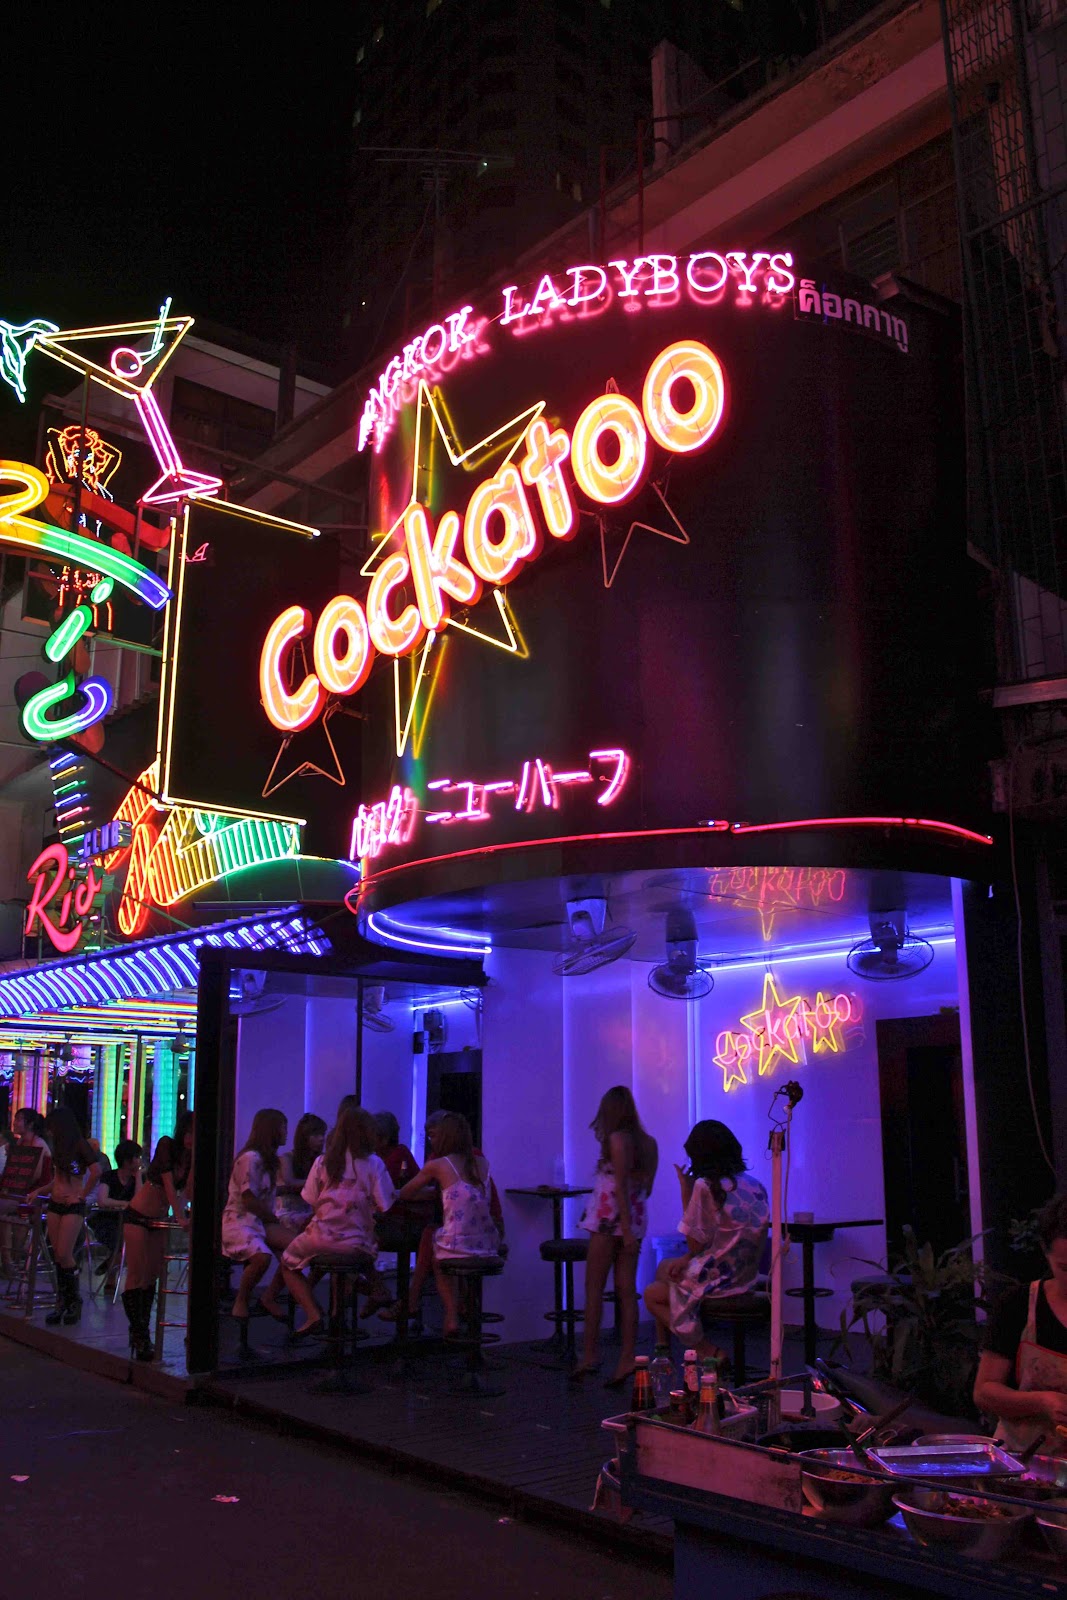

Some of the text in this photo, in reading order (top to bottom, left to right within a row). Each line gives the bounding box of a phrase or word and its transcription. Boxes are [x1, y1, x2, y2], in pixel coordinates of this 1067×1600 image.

[500, 251, 796, 325] LADYBOYS
[258, 339, 728, 733] Cockatoo
[84, 820, 120, 858] CLUB
